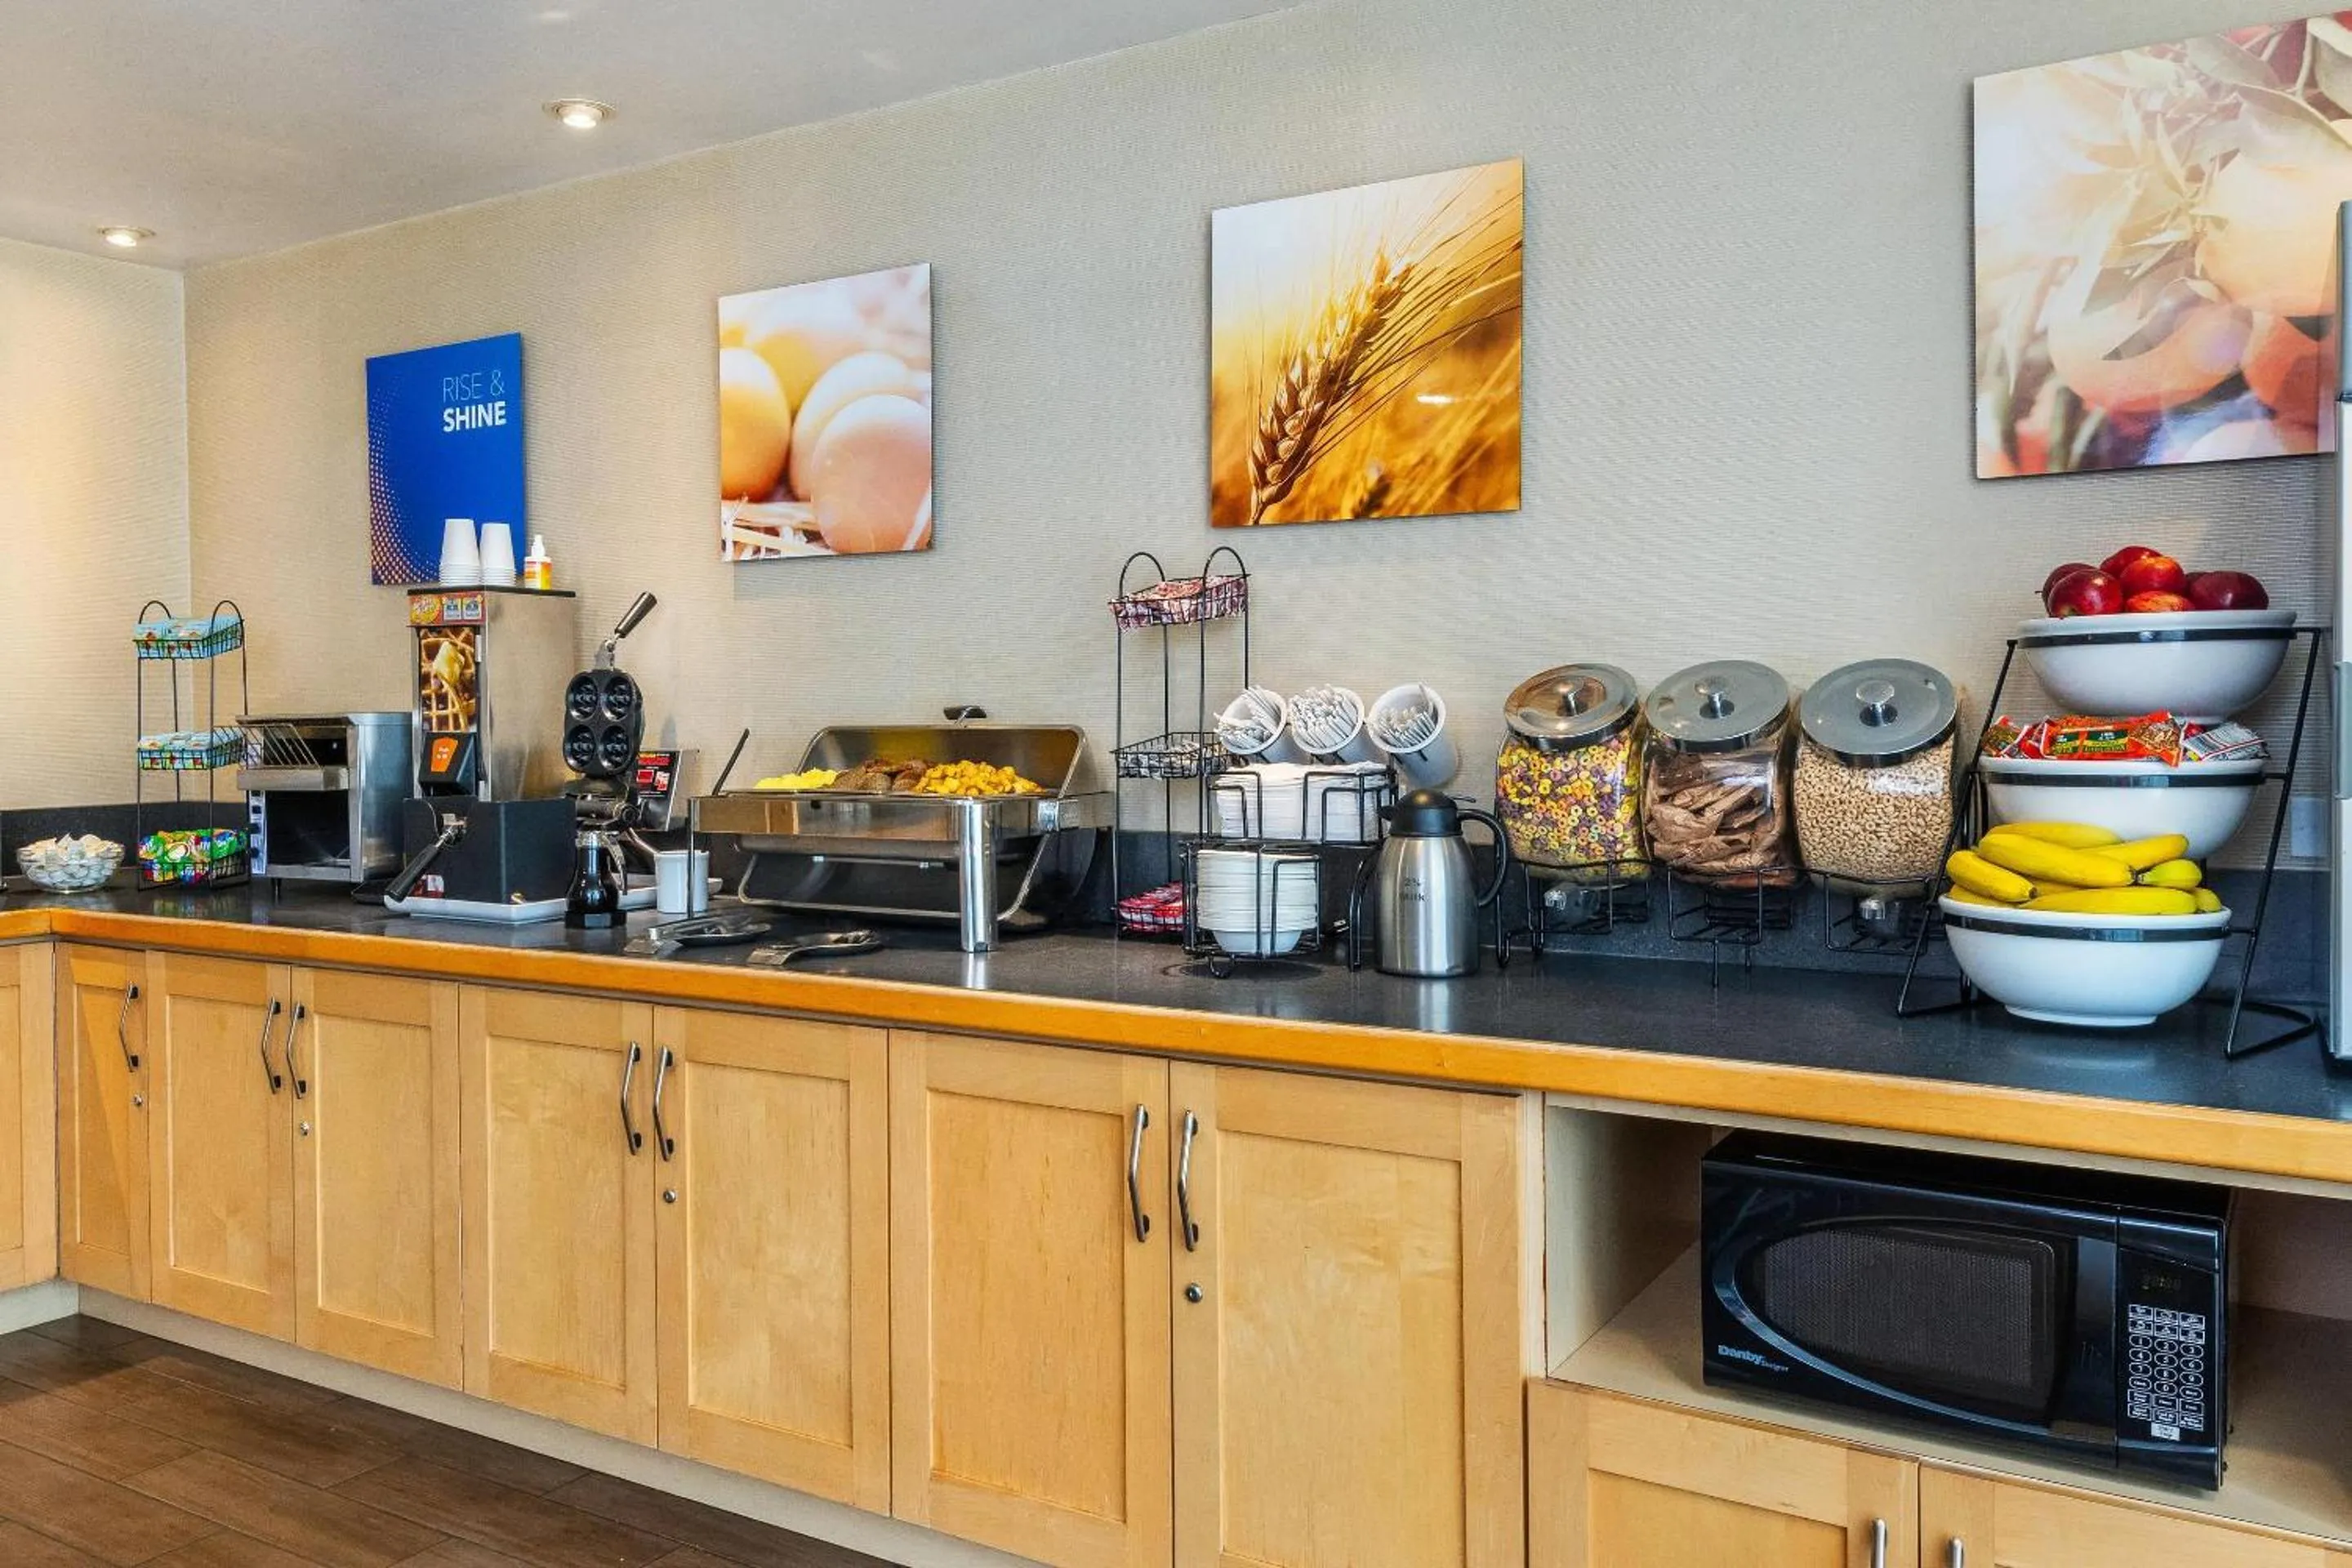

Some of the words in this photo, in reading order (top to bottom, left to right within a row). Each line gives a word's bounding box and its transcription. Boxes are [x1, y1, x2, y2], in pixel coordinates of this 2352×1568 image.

[443, 372, 483, 403] RISE
[490, 369, 506, 397] &
[443, 400, 506, 432] SHINE
